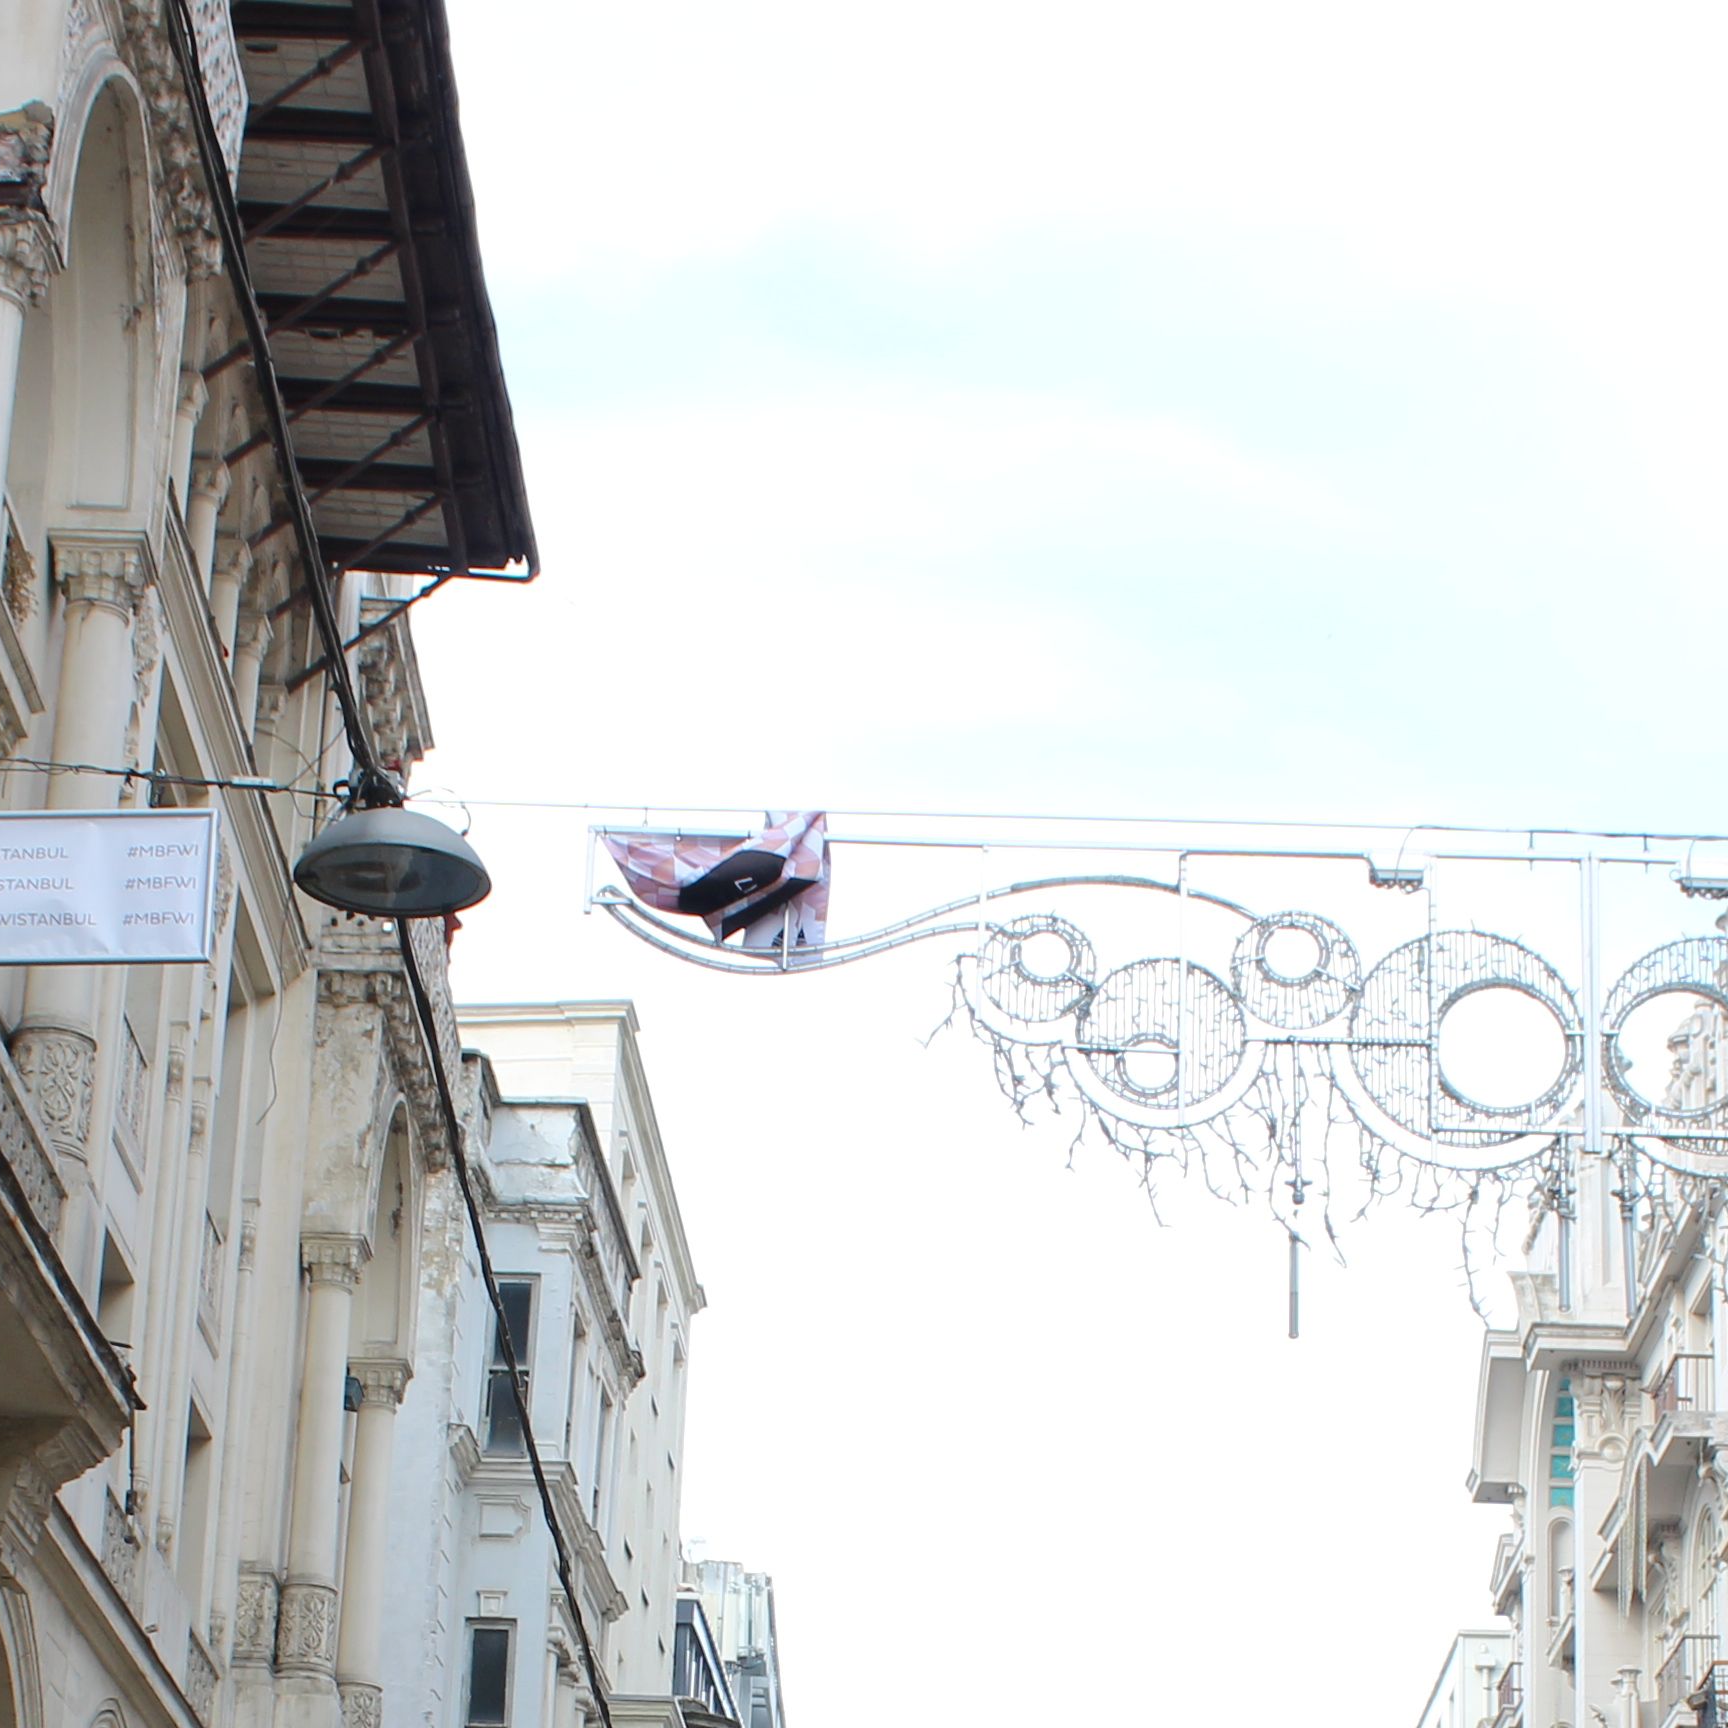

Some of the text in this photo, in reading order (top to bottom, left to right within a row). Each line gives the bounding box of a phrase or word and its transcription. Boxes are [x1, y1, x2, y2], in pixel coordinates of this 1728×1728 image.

[127, 843, 200, 860] #MBFWI
[124, 875, 197, 892] #MBFWI
[122, 910, 195, 927] #MBFWI
